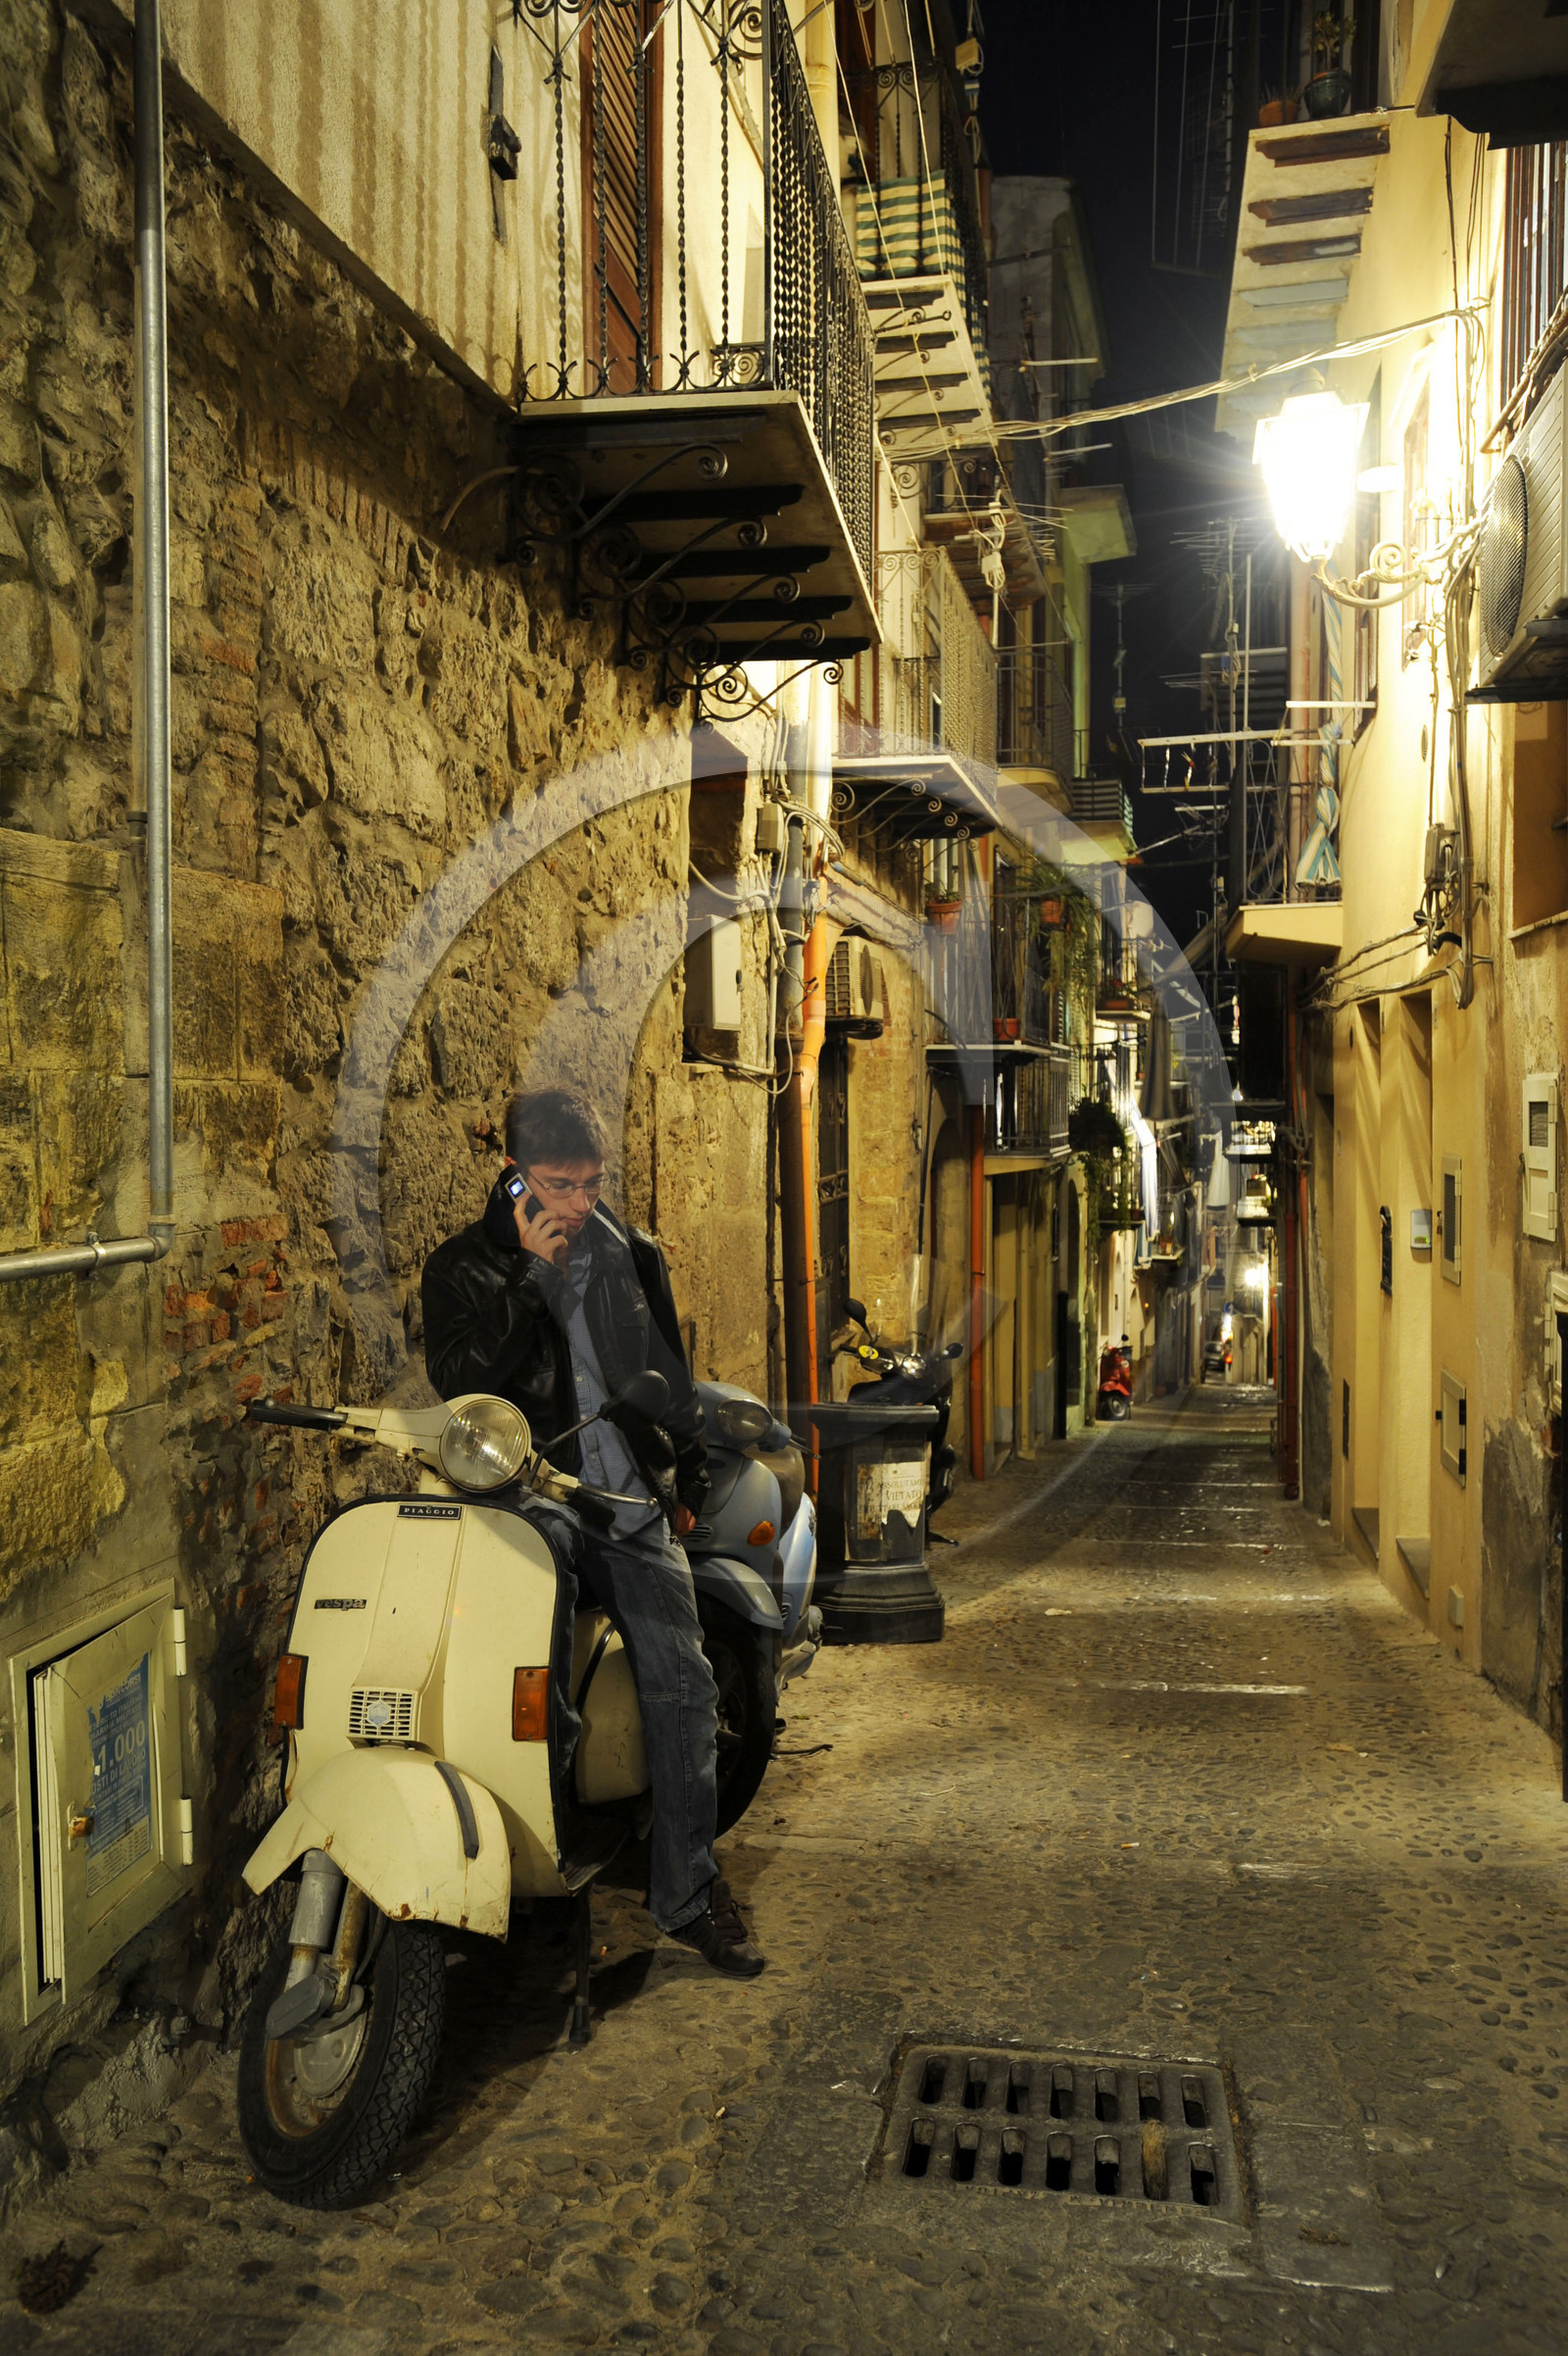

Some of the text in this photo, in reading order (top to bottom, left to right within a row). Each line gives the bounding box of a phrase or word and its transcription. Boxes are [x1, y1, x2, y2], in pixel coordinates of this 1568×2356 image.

[886, 1489, 922, 1500] VIETATO
[315, 1598, 367, 1611] vespa
[99, 1720, 145, 1773] 1.000
[92, 1773, 108, 1794] OSTI
[111, 1767, 117, 1781] DI
[120, 1747, 145, 1776] LAVORO
